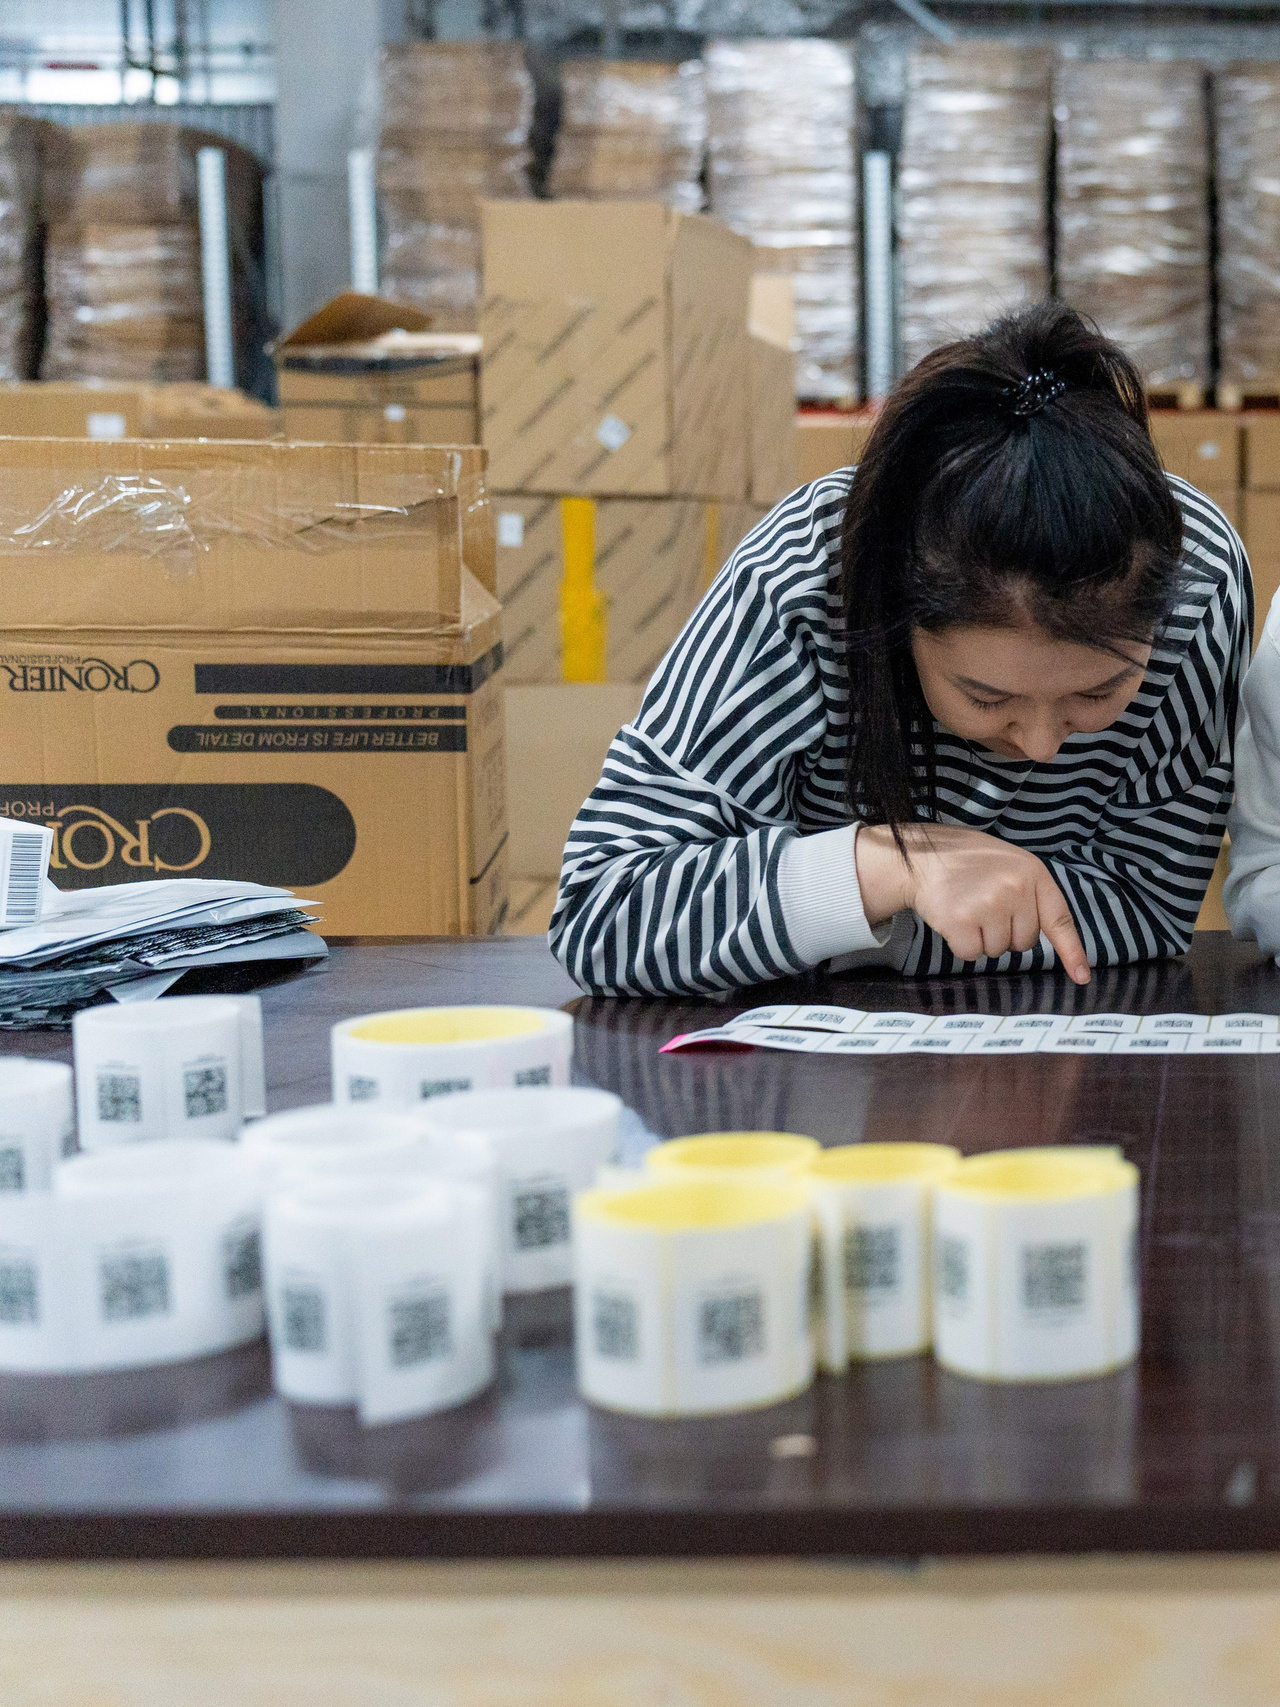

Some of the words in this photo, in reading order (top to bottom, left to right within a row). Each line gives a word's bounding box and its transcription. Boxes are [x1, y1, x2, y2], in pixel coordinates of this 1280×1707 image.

[0, 657, 160, 693] CRONIER
[246, 706, 440, 718] PROFESSIONAL
[195, 731, 255, 747] DETAIL
[257, 731, 309, 747] FROM
[312, 731, 329, 747] IS
[332, 731, 370, 747] LIFE
[371, 731, 440, 747] BETTER
